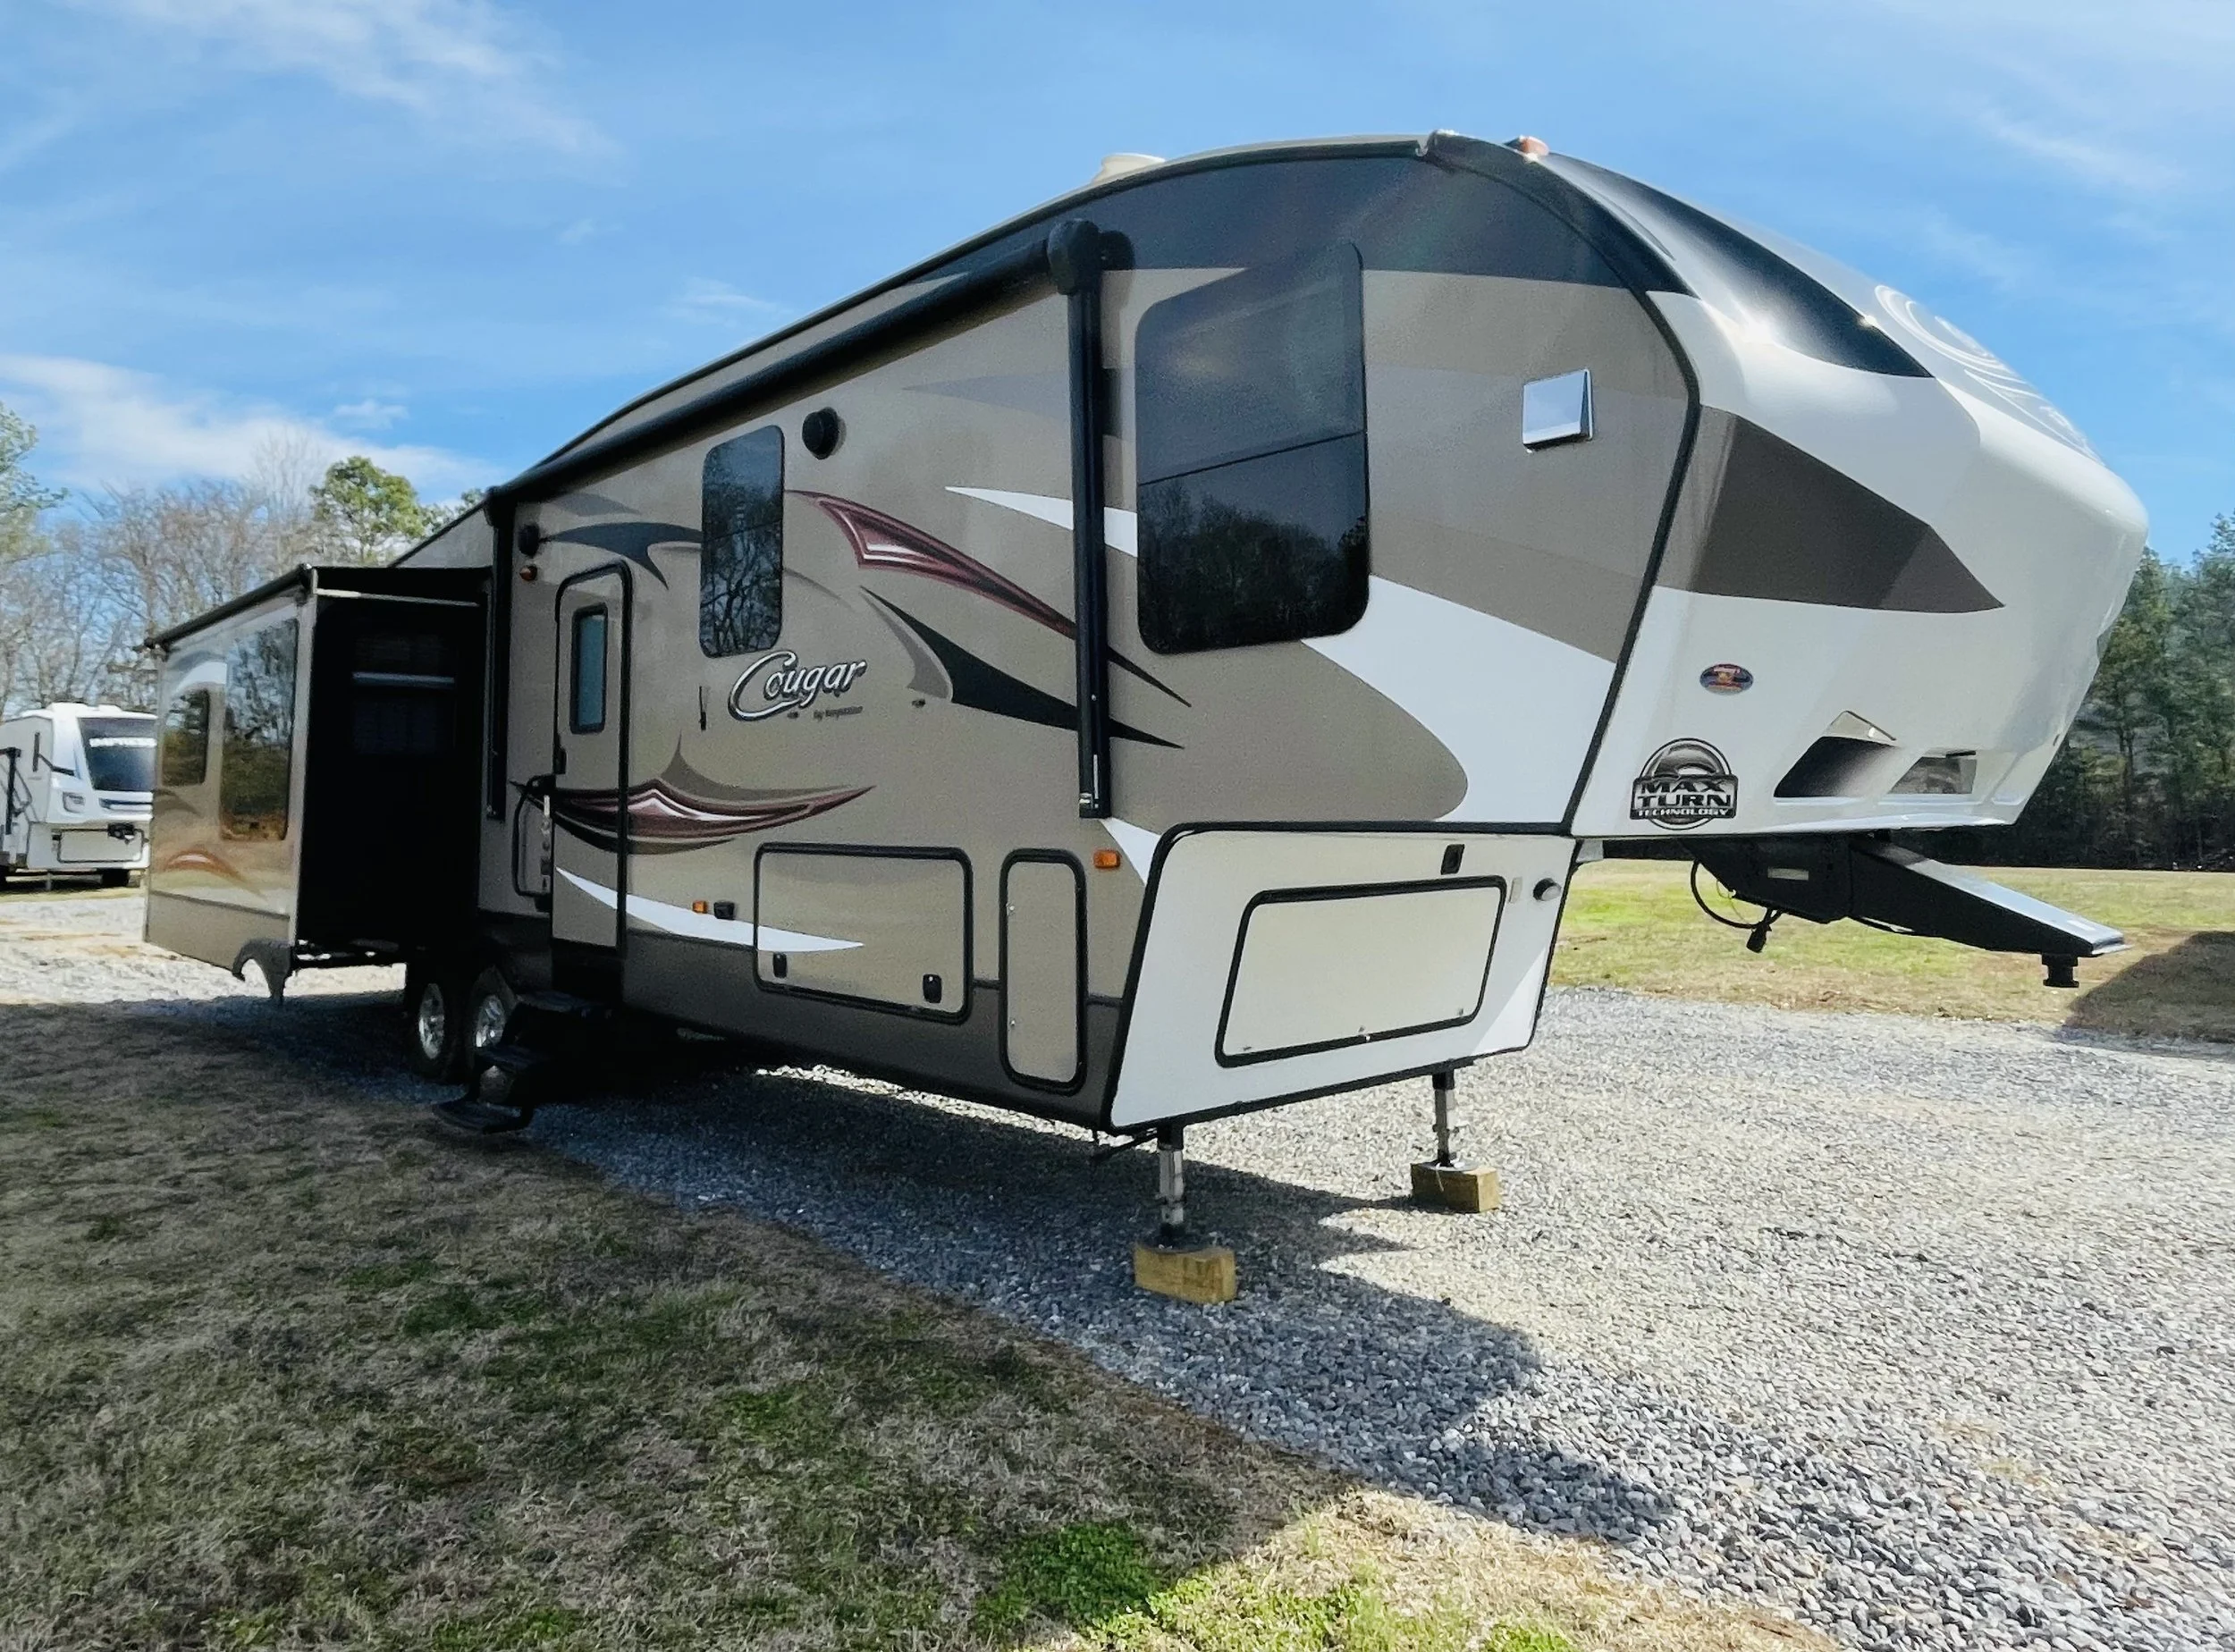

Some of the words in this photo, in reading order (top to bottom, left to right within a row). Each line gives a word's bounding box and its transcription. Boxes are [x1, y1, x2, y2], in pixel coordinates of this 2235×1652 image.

[728, 649, 867, 721] Cougar
[1641, 780, 1725, 794] MAX
[1637, 794, 1732, 807] TURN
